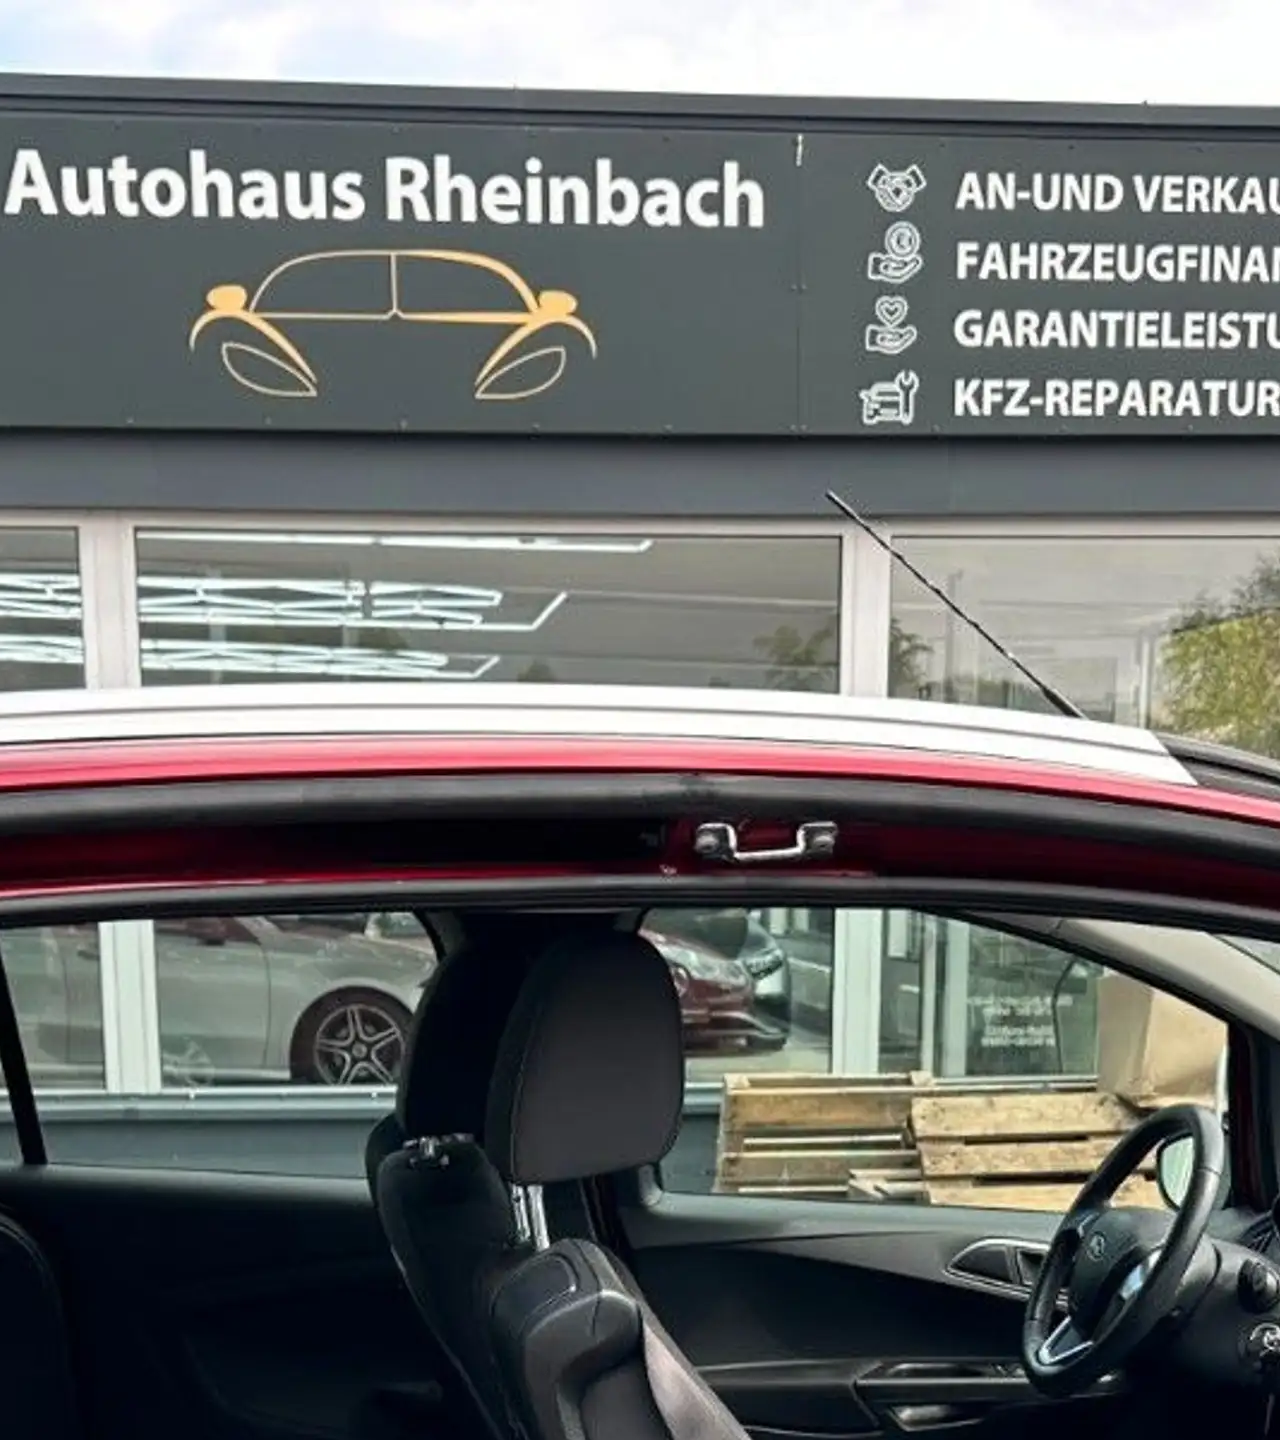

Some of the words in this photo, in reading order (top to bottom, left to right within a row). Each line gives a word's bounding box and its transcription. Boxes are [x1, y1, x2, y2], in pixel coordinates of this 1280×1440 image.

[4, 150, 366, 220] Autohaus
[386, 155, 764, 227] Rheinbach
[956, 172, 1123, 212] AN-UND
